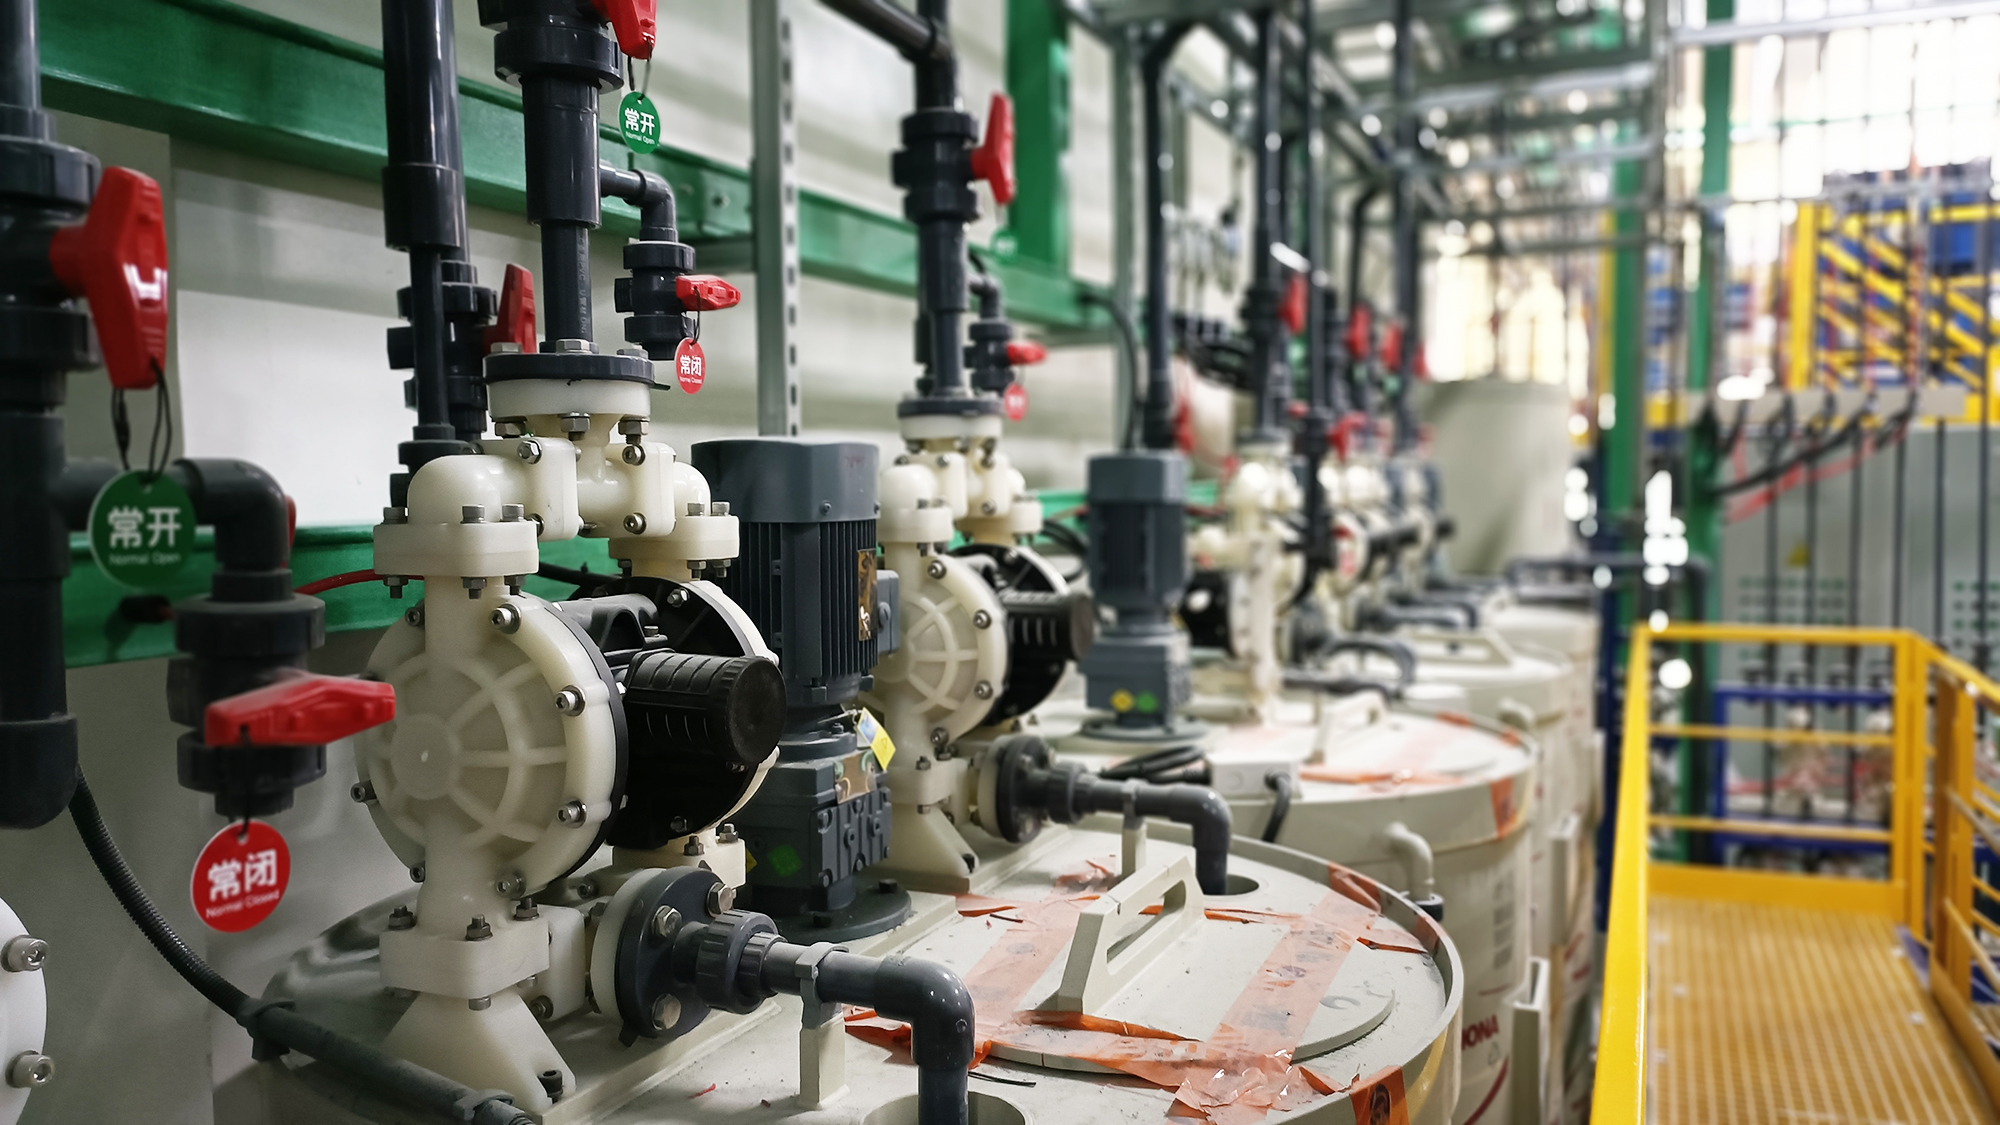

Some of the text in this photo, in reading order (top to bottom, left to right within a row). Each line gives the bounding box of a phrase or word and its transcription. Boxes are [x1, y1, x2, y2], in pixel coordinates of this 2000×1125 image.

[625, 107, 655, 135] 常开
[680, 355, 702, 376] 常闭
[107, 505, 182, 548] 常开
[108, 551, 181, 566] Normal Open
[207, 848, 278, 902] 常闭
[206, 889, 280, 918] Normal Closed
